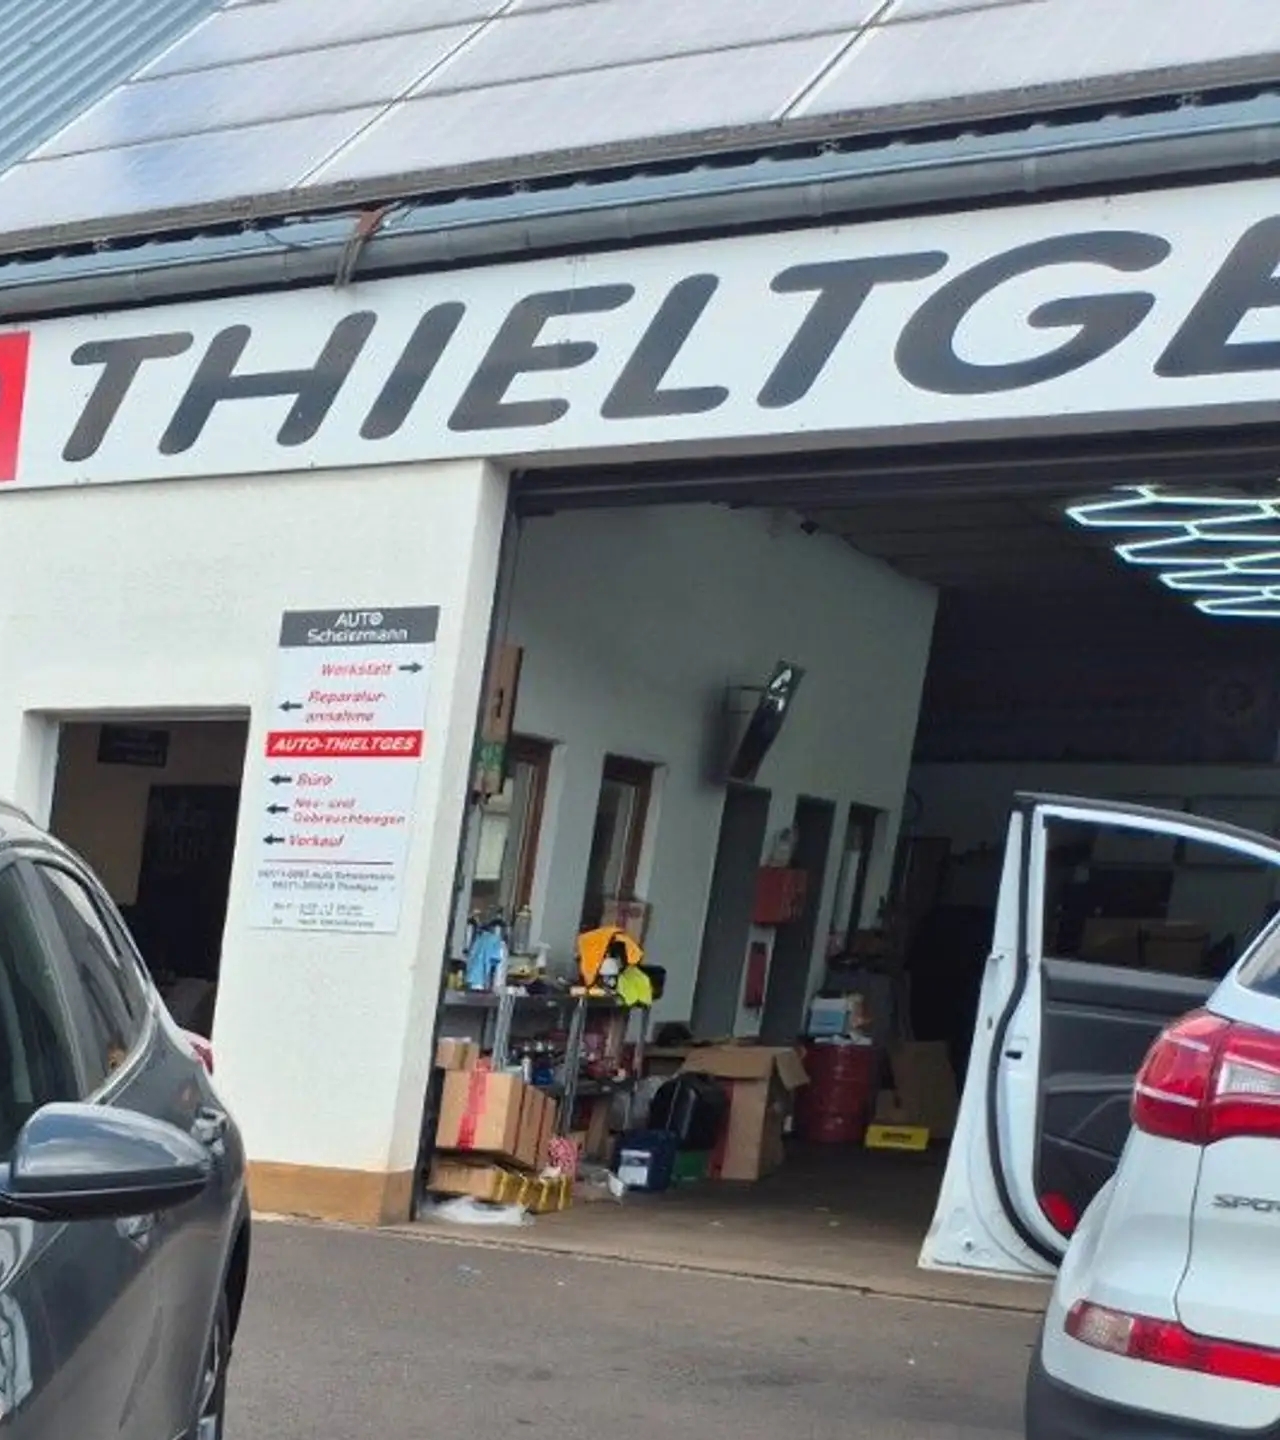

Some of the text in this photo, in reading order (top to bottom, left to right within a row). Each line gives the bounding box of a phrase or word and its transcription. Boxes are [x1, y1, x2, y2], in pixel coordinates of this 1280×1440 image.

[334, 611, 384, 628] AUTO
[272, 736, 418, 751] AUTO-THIELTGES
[296, 773, 333, 786] Büro
[290, 834, 345, 847] Verkauf
[1212, 1193, 1280, 1212] SPO
